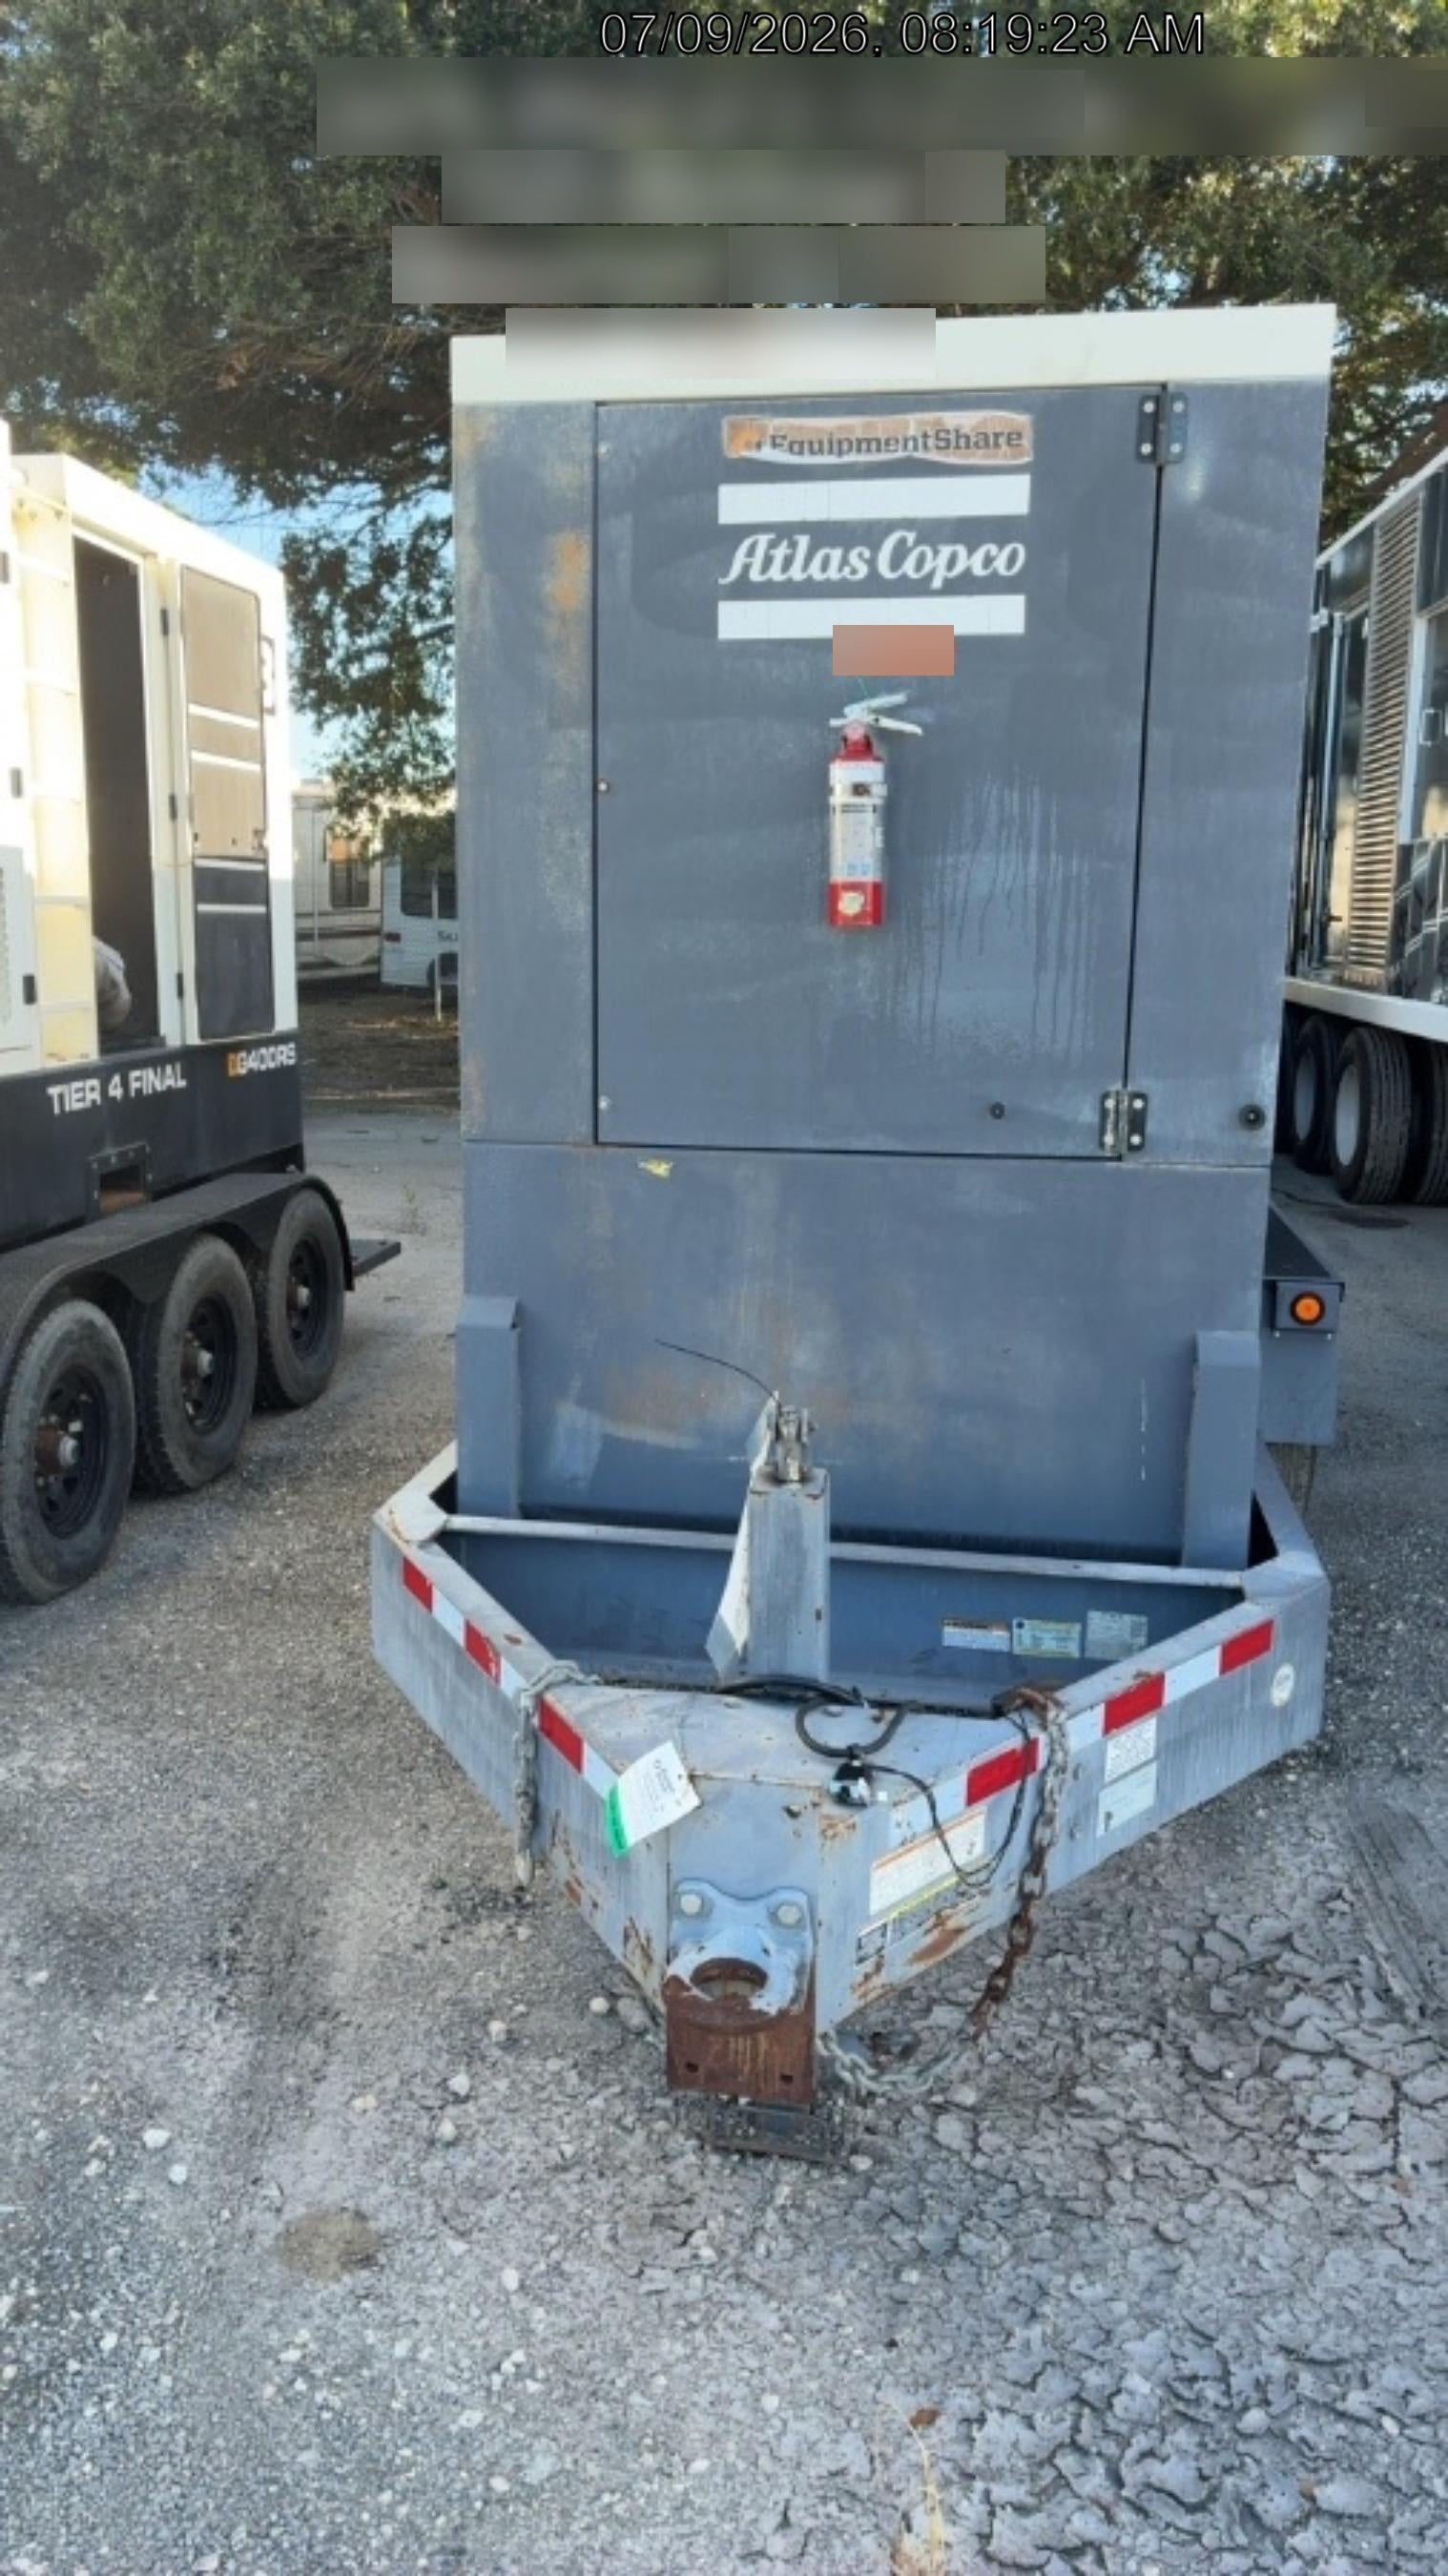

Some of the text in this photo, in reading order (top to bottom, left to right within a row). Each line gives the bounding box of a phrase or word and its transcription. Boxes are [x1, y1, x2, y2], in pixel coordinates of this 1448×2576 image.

[717, 529, 1027, 590] Atlas Copco
[47, 1061, 188, 1115] TIER 4 FINAL
